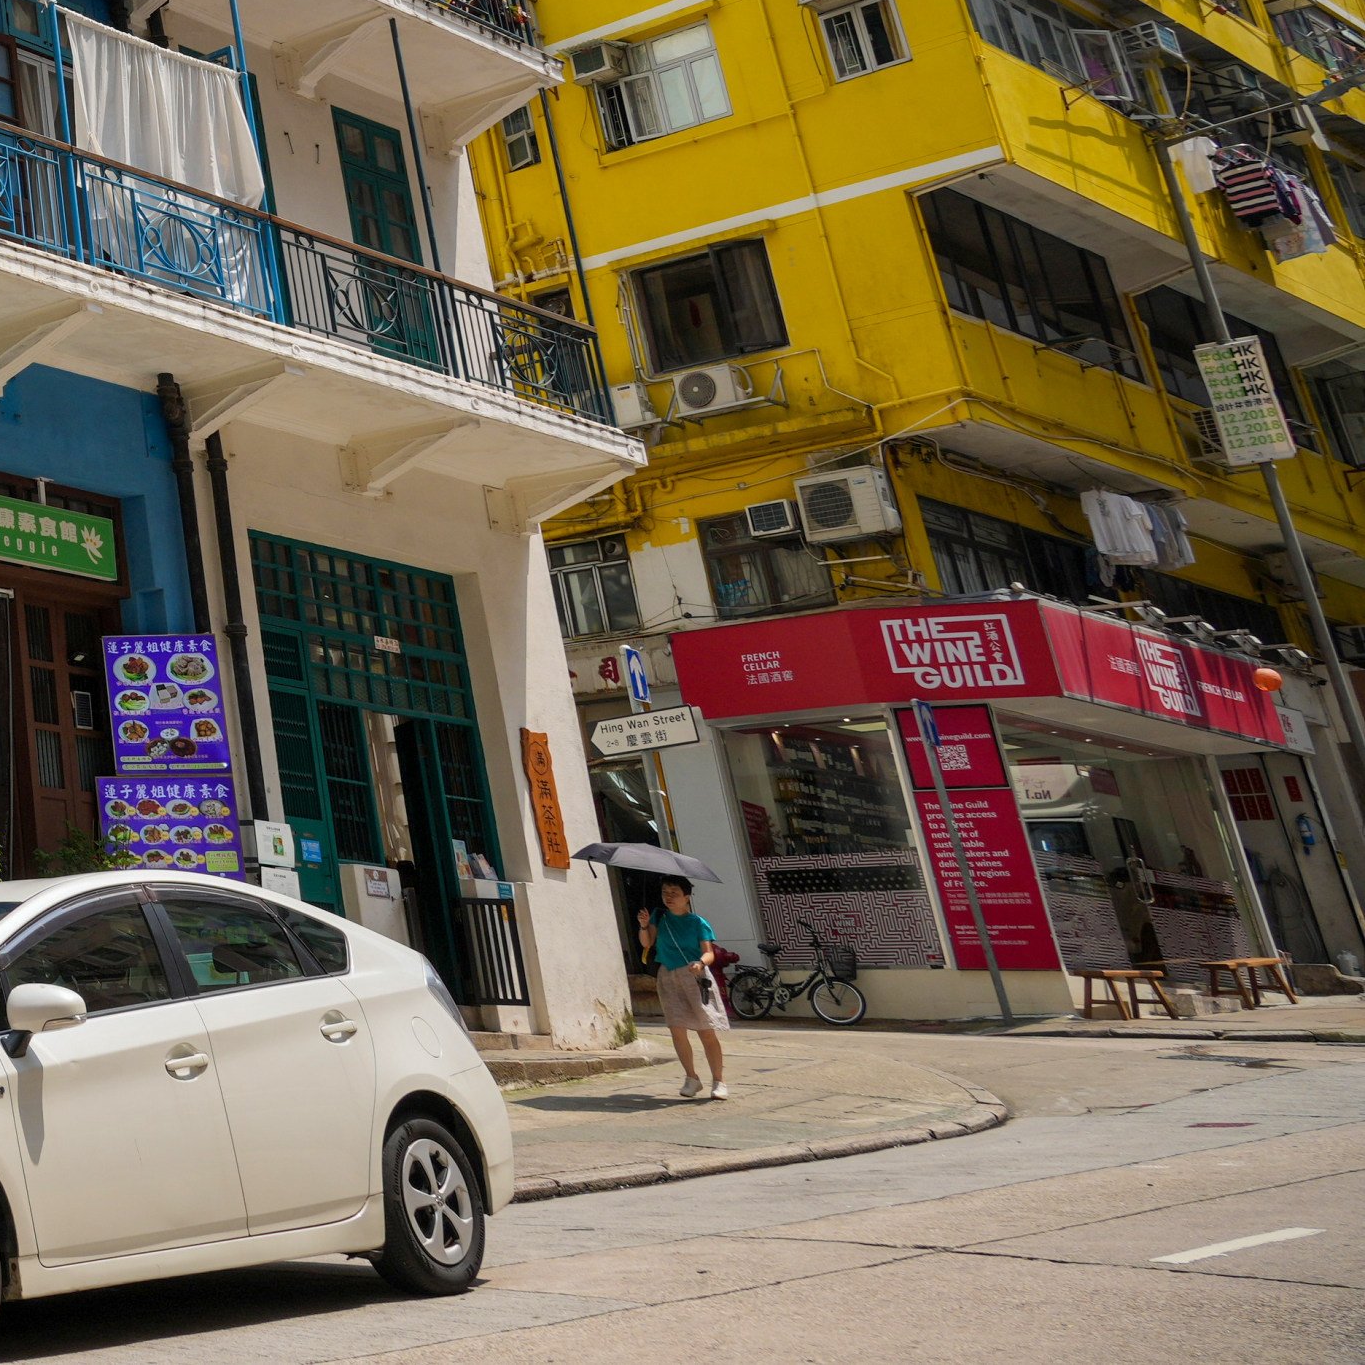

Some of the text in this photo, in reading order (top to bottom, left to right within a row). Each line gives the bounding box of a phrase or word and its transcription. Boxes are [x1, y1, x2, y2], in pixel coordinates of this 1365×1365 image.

[1199, 343, 1256, 362] #ddHK
[1204, 356, 1261, 374] #ddHK
[1208, 369, 1266, 387] #ddHK
[1213, 382, 1269, 401] #ddHK
[1220, 407, 1278, 424] 12.2018
[1224, 420, 1282, 437] 12.2018
[1228, 432, 1286, 450] 12.2018
[882, 616, 946, 641] THE
[107, 639, 212, 654] 蓮子麗姐健康素食
[982, 621, 1004, 663] 紅酒公會
[1135, 637, 1164, 663] THE
[741, 650, 780, 663] FRENCH
[900, 638, 987, 665] WINE
[570, 656, 620, 685] 司
[743, 660, 780, 672] CELLAR
[745, 669, 794, 685] 法國酒窖
[914, 664, 1020, 689] GUILD
[1148, 661, 1182, 691] WINE
[1196, 680, 1245, 703] FRENCH CELLAR
[1158, 688, 1198, 716] GUILD
[600, 711, 686, 734] Hing Wan Street
[626, 730, 668, 747] 慶雲街
[104, 783, 230, 799] 蓮子麗姐健康素食
[965, 800, 989, 809] Guild
[926, 812, 964, 821] proves
[969, 830, 979, 838] of
[933, 840, 985, 849] sustnable
[935, 849, 1009, 858] wineakers and
[939, 859, 1003, 868] delivs wines
[976, 869, 1010, 879] regions
[954, 880, 989, 888] Frce.
[835, 918, 855, 927] WINE
[838, 926, 862, 935] GUILD
